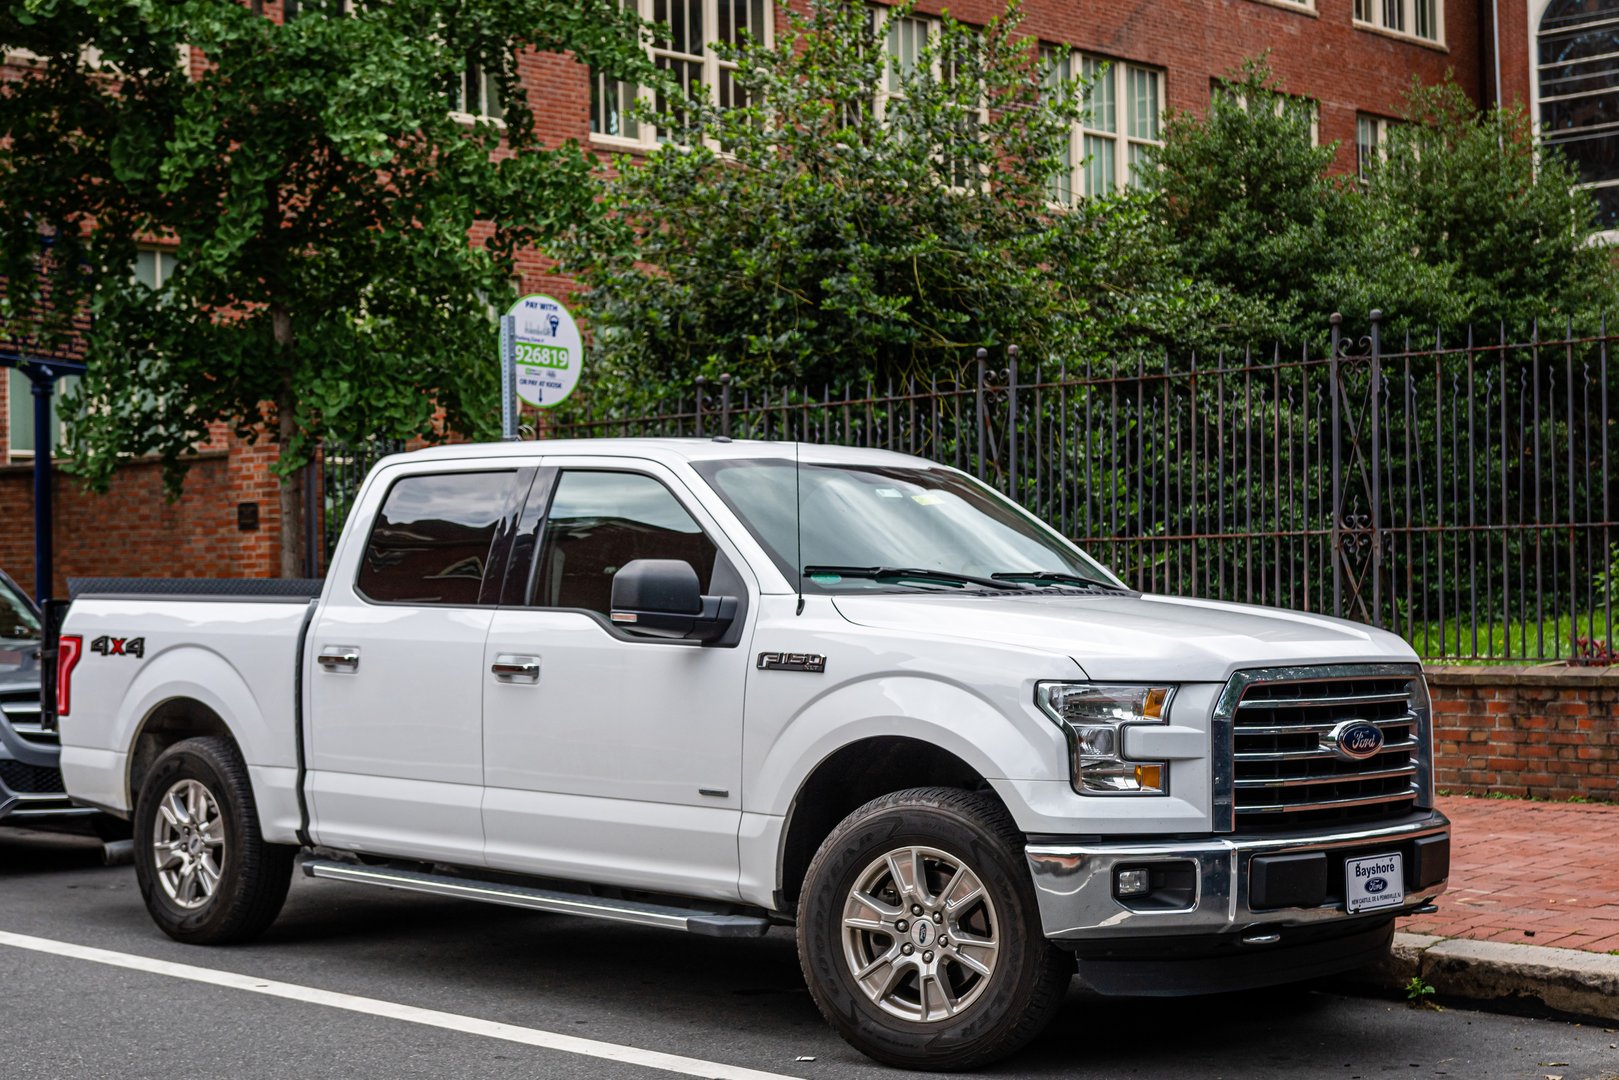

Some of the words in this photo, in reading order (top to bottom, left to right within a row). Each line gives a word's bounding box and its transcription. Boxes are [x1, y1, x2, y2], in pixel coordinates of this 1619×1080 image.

[525, 301, 537, 309] PAY
[540, 302, 558, 311] WITH
[515, 345, 568, 367] 926819
[1352, 730, 1376, 749] Ford
[1355, 863, 1395, 878] Bayshore
[1369, 879, 1384, 891] Ford
